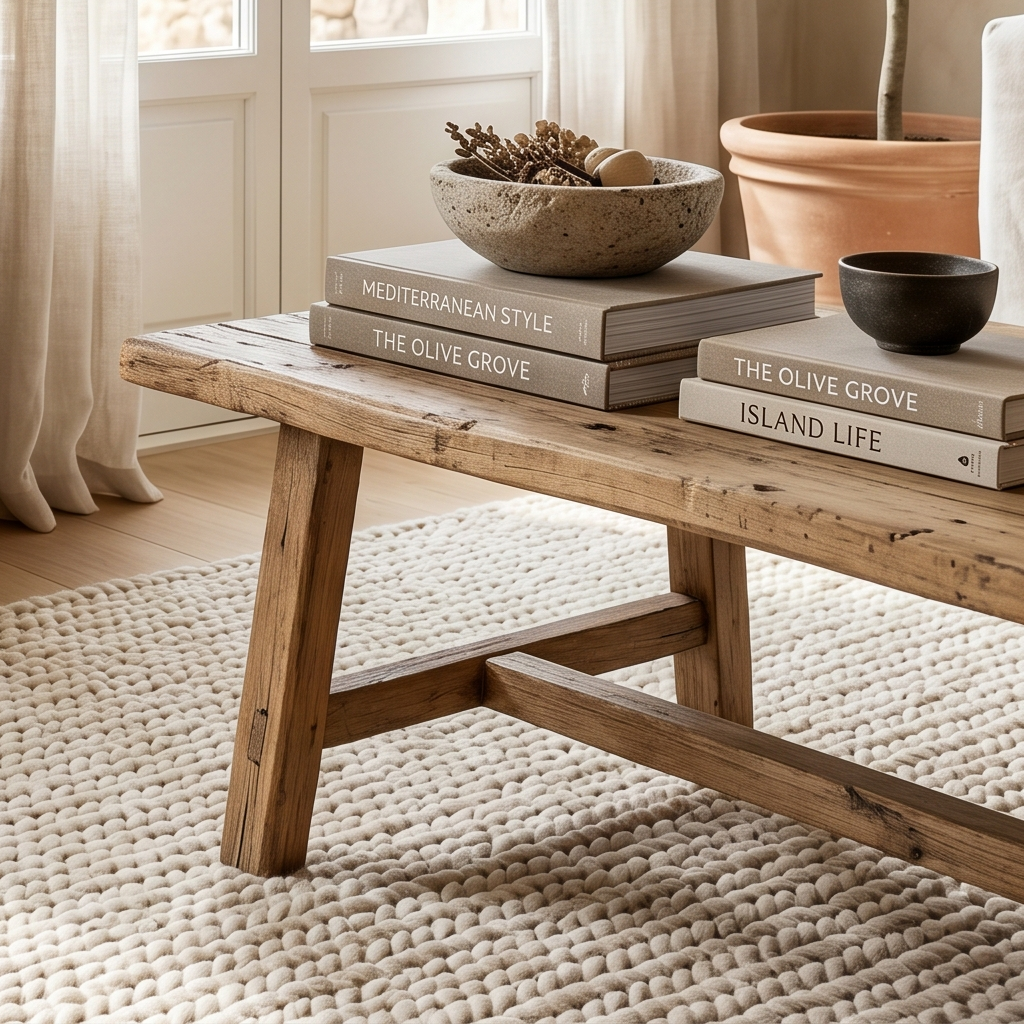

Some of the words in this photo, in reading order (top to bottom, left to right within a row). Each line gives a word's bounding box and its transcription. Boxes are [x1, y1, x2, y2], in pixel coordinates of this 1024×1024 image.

[362, 279, 497, 323] MEDITERRANEAN
[500, 307, 553, 334] STYLE
[372, 328, 406, 354] THE
[411, 338, 462, 366] OLIVE
[467, 350, 530, 381] GROVE
[733, 357, 773, 383] THE
[778, 366, 838, 396] OLIVE
[845, 380, 918, 412] GROVE
[740, 402, 824, 439] ISLAND
[833, 422, 882, 453] LIFE
